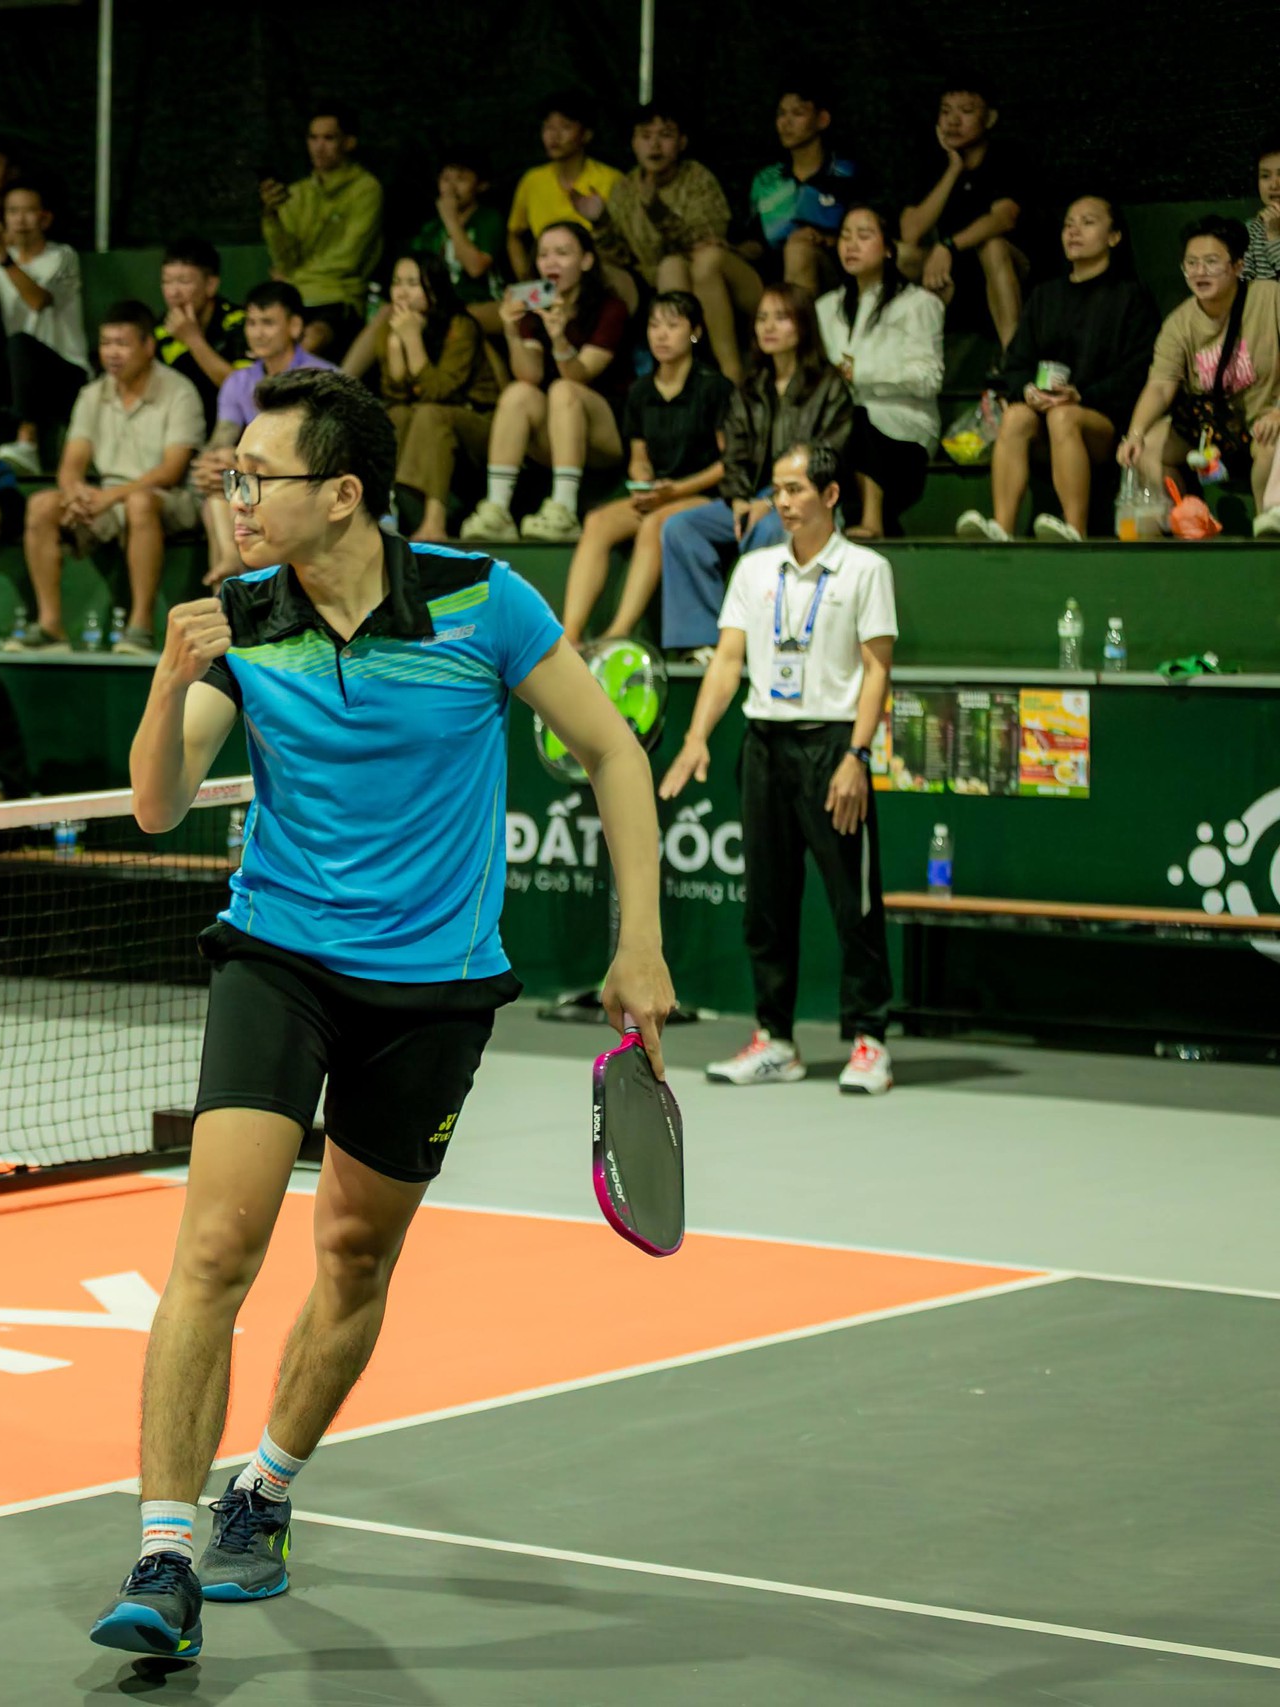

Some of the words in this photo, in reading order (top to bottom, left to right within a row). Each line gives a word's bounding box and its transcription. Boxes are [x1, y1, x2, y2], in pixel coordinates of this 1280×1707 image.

[658, 798, 746, 876] ỐC
[593, 1111, 602, 1142] JOOLA
[606, 1150, 626, 1203] JOOLA
